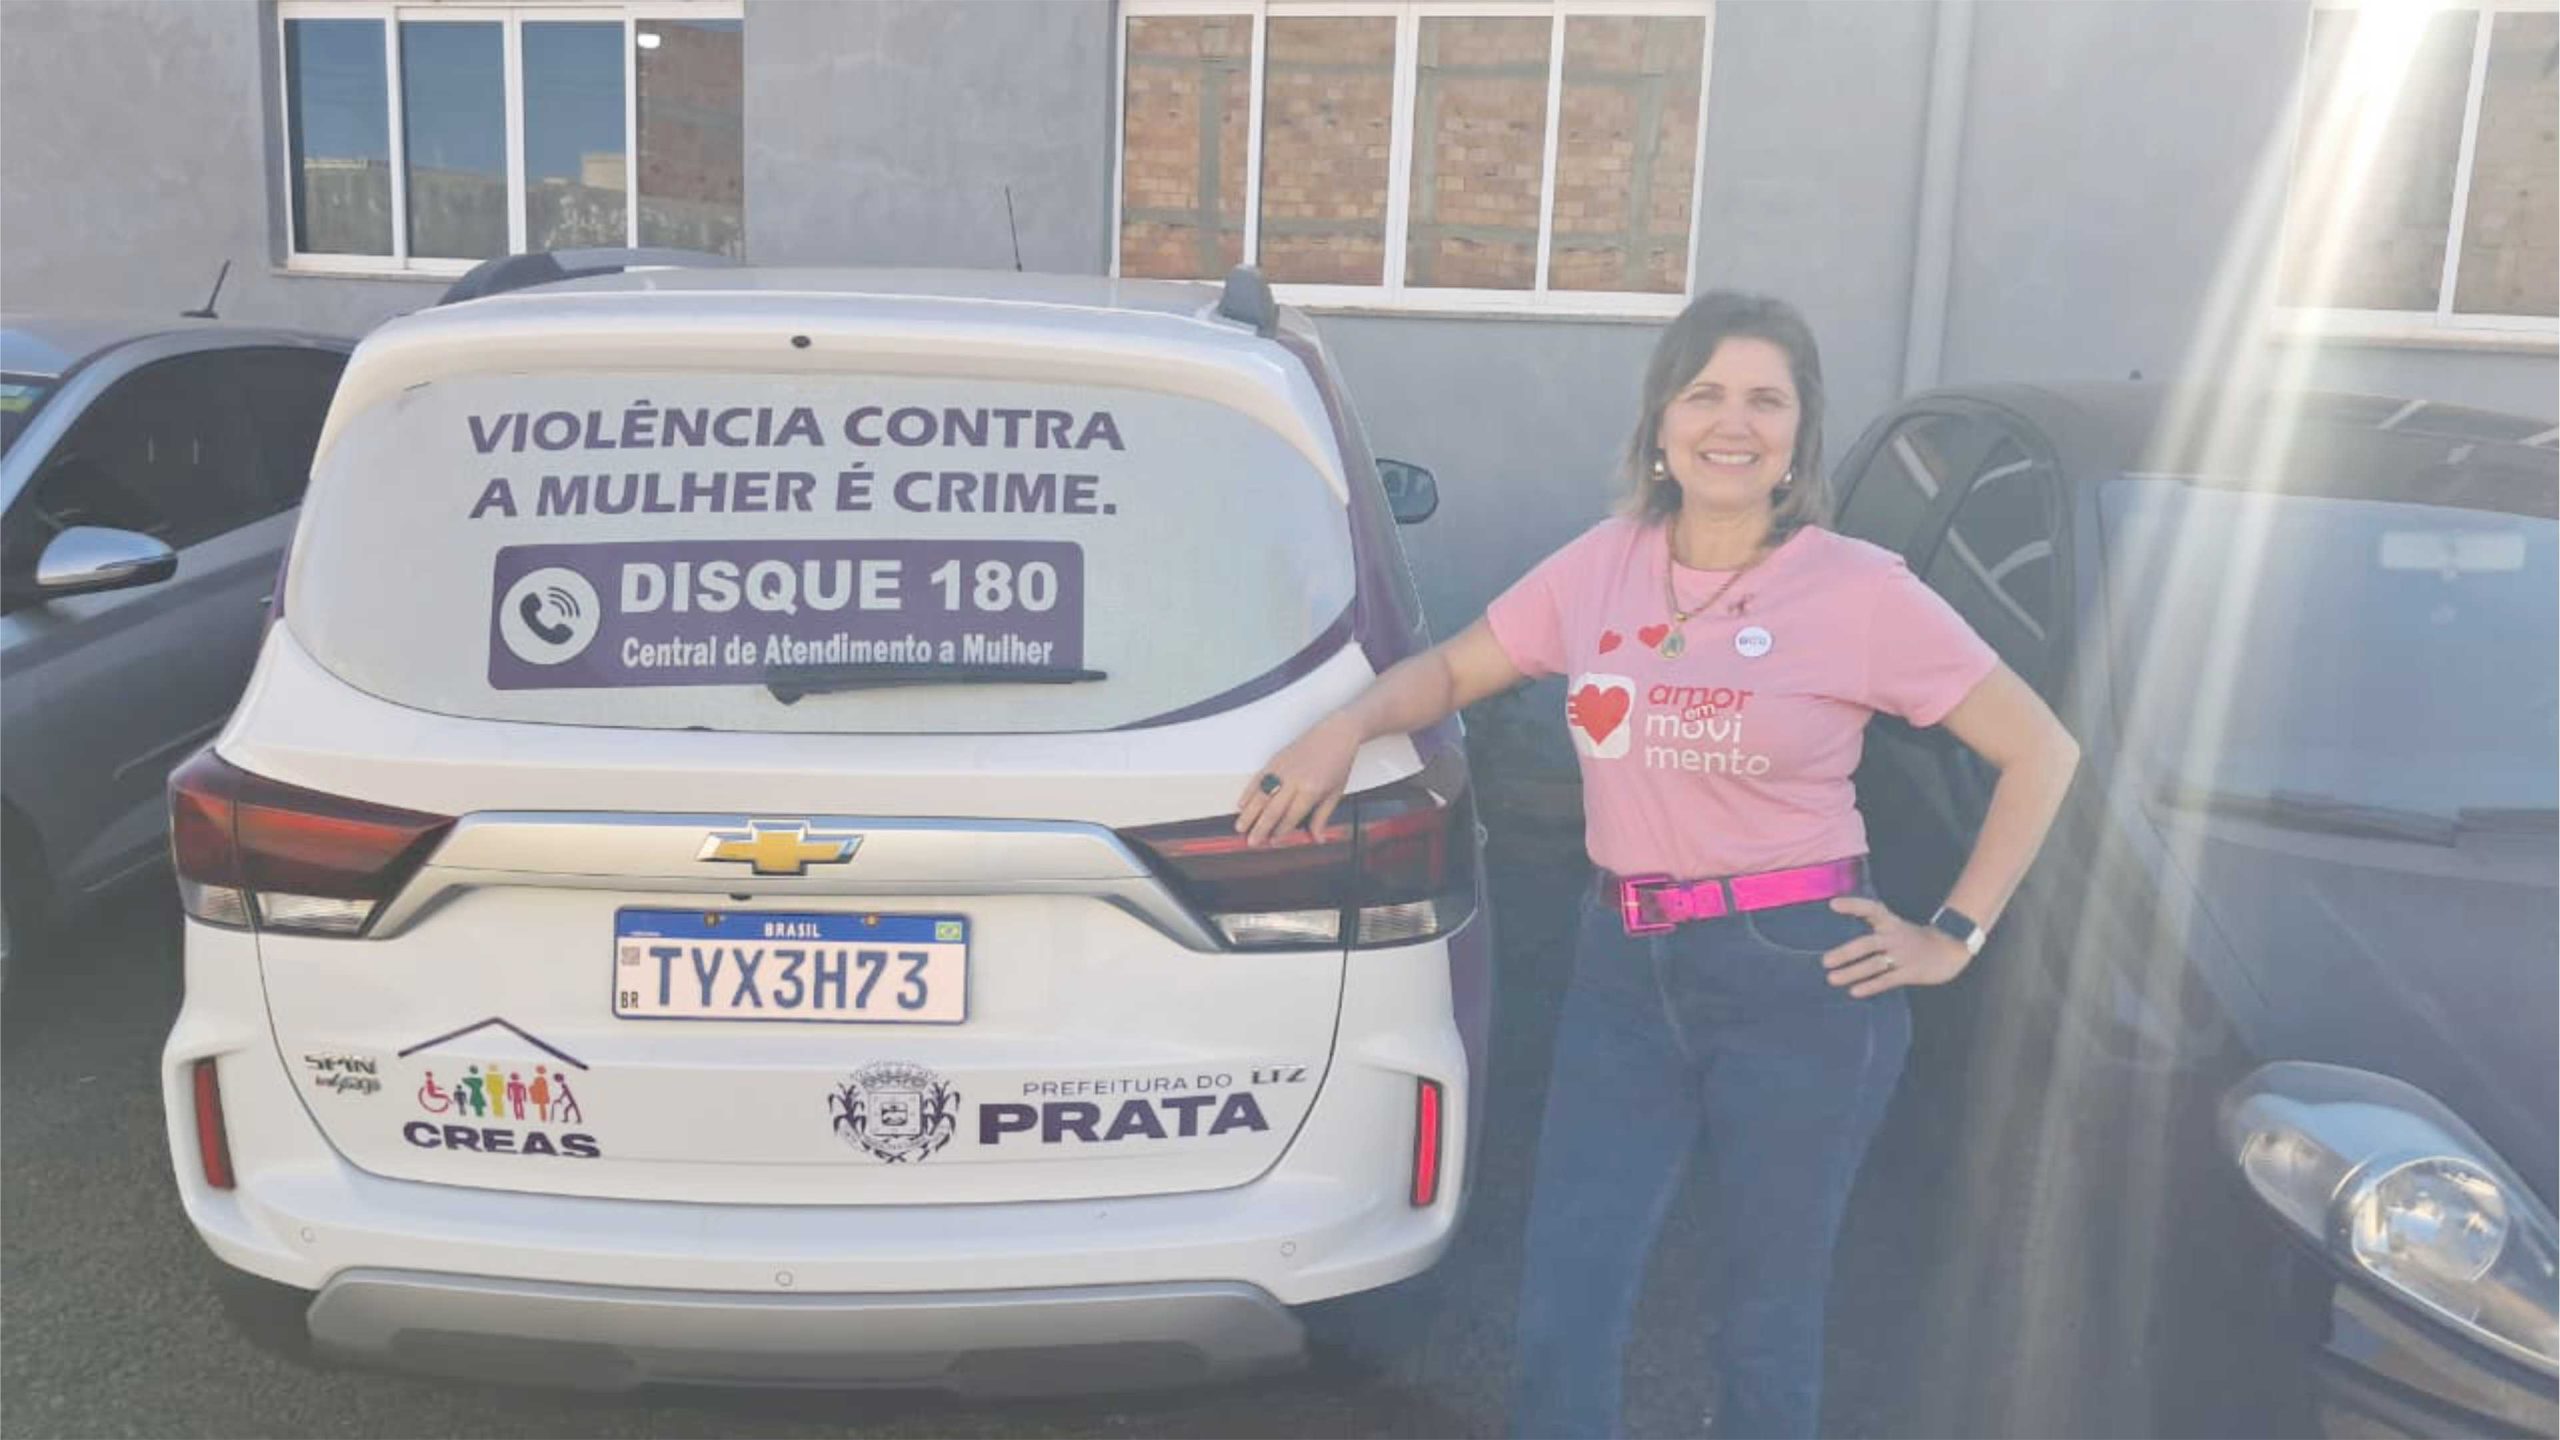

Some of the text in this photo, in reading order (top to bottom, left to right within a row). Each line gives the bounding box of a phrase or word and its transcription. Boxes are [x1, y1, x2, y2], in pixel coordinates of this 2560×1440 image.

[467, 400, 1125, 453] VIOLÊNCIA CONTRA
[468, 462, 1118, 518] A MULHER É CRIME.
[620, 559, 1058, 616] DISQUE 180
[622, 633, 1054, 667] Central de Atendimento a Mulher
[1648, 683, 1754, 711] amor
[1684, 704, 1716, 721] em
[1646, 745, 1770, 775] mento
[764, 921, 822, 939] BRASIL
[649, 946, 929, 1010] TYX3H73
[620, 991, 640, 1009] BR
[1023, 1073, 1233, 1097] PREFEITURA DO
[979, 1091, 1270, 1145] PRATA
[403, 1121, 600, 1158] CREAS
